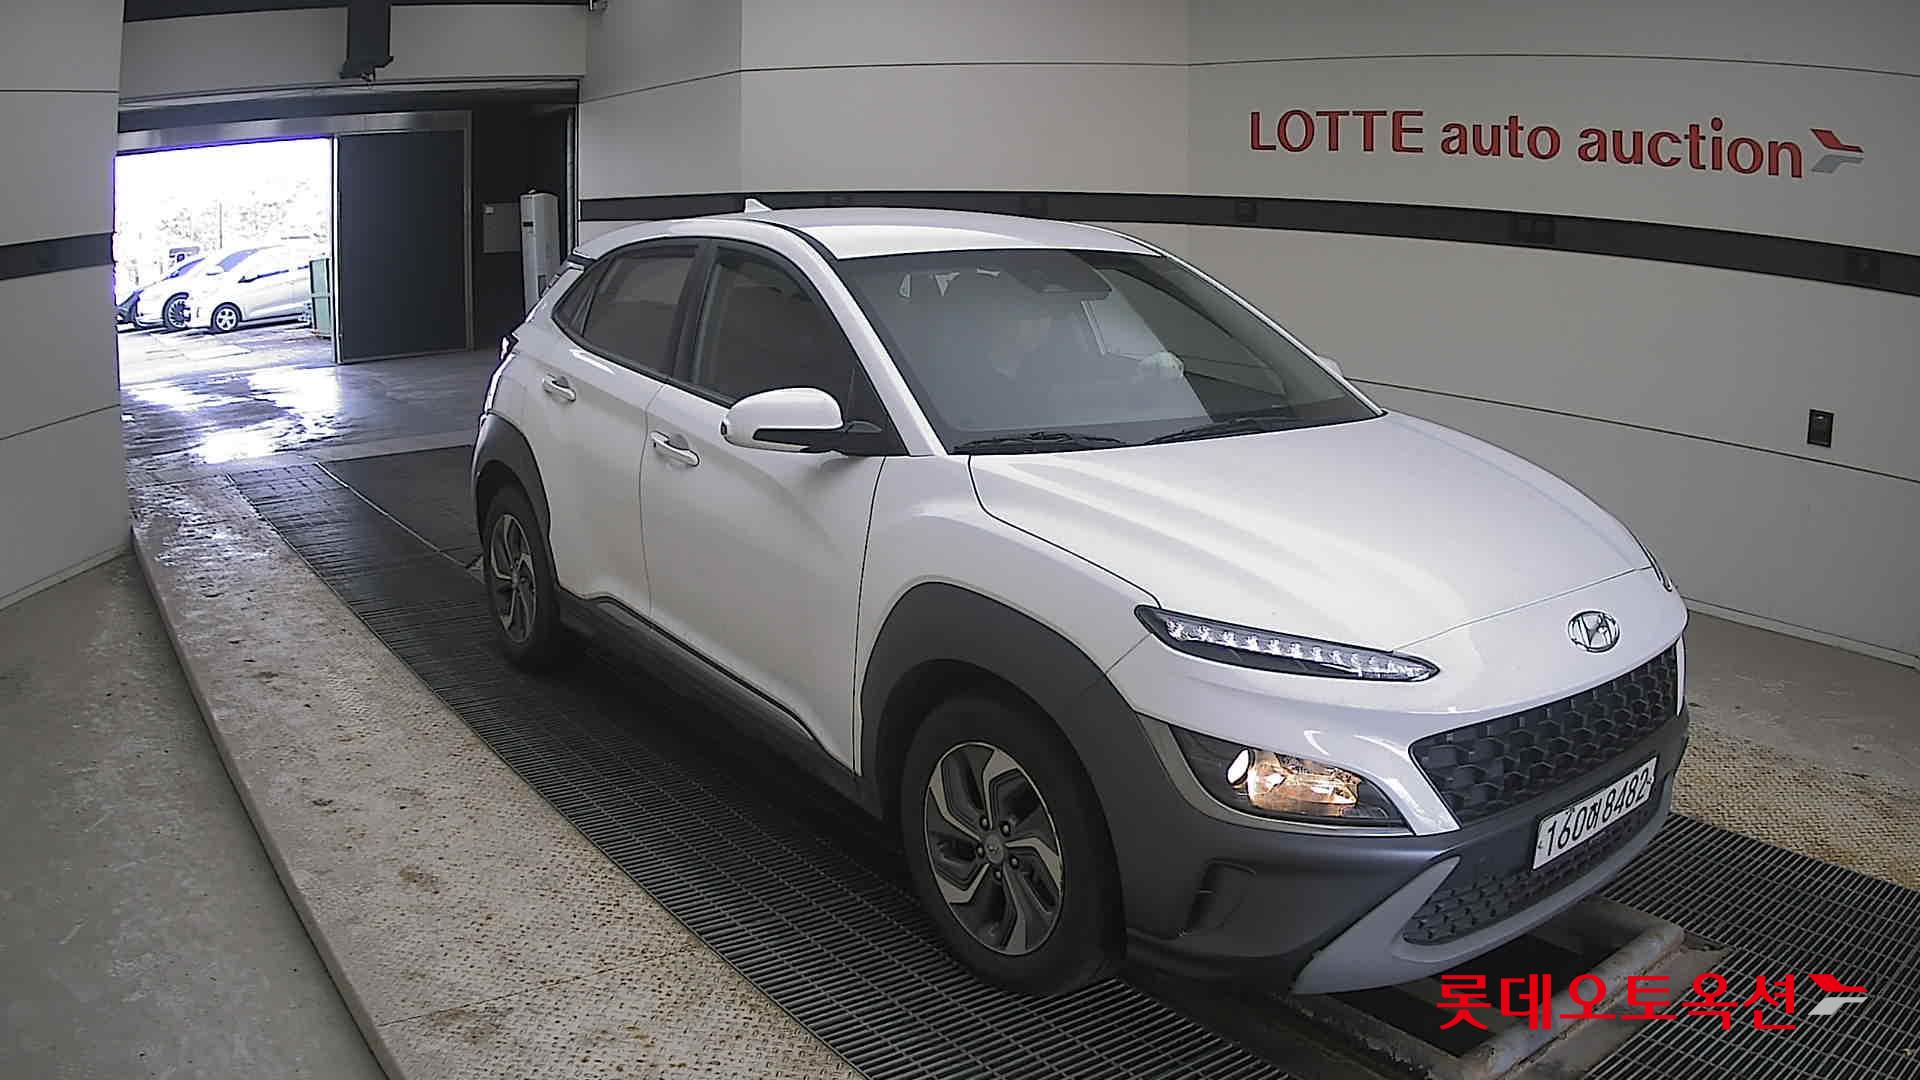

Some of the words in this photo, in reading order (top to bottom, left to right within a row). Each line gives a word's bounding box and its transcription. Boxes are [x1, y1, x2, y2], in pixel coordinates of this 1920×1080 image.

[1249, 109, 1425, 154] LOTTE
[1439, 115, 1562, 161] auto
[1576, 117, 1804, 178] auction
